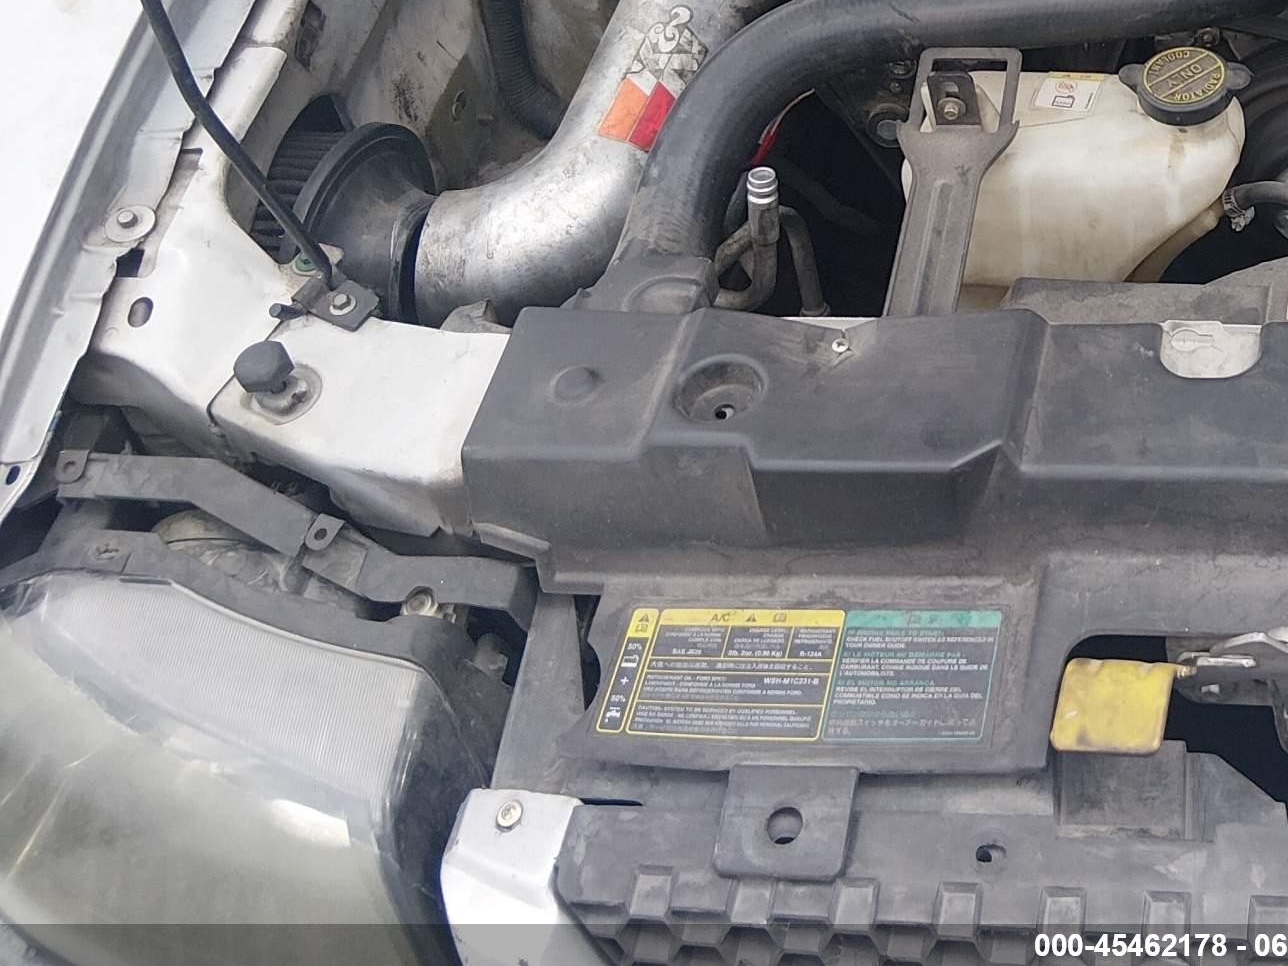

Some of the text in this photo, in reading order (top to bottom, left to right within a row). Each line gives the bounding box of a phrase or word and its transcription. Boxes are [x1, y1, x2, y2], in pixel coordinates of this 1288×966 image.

[1148, 50, 1190, 74] COOLANT
[1166, 64, 1202, 88] ONLY
[1174, 74, 1220, 101] RADIATOR
